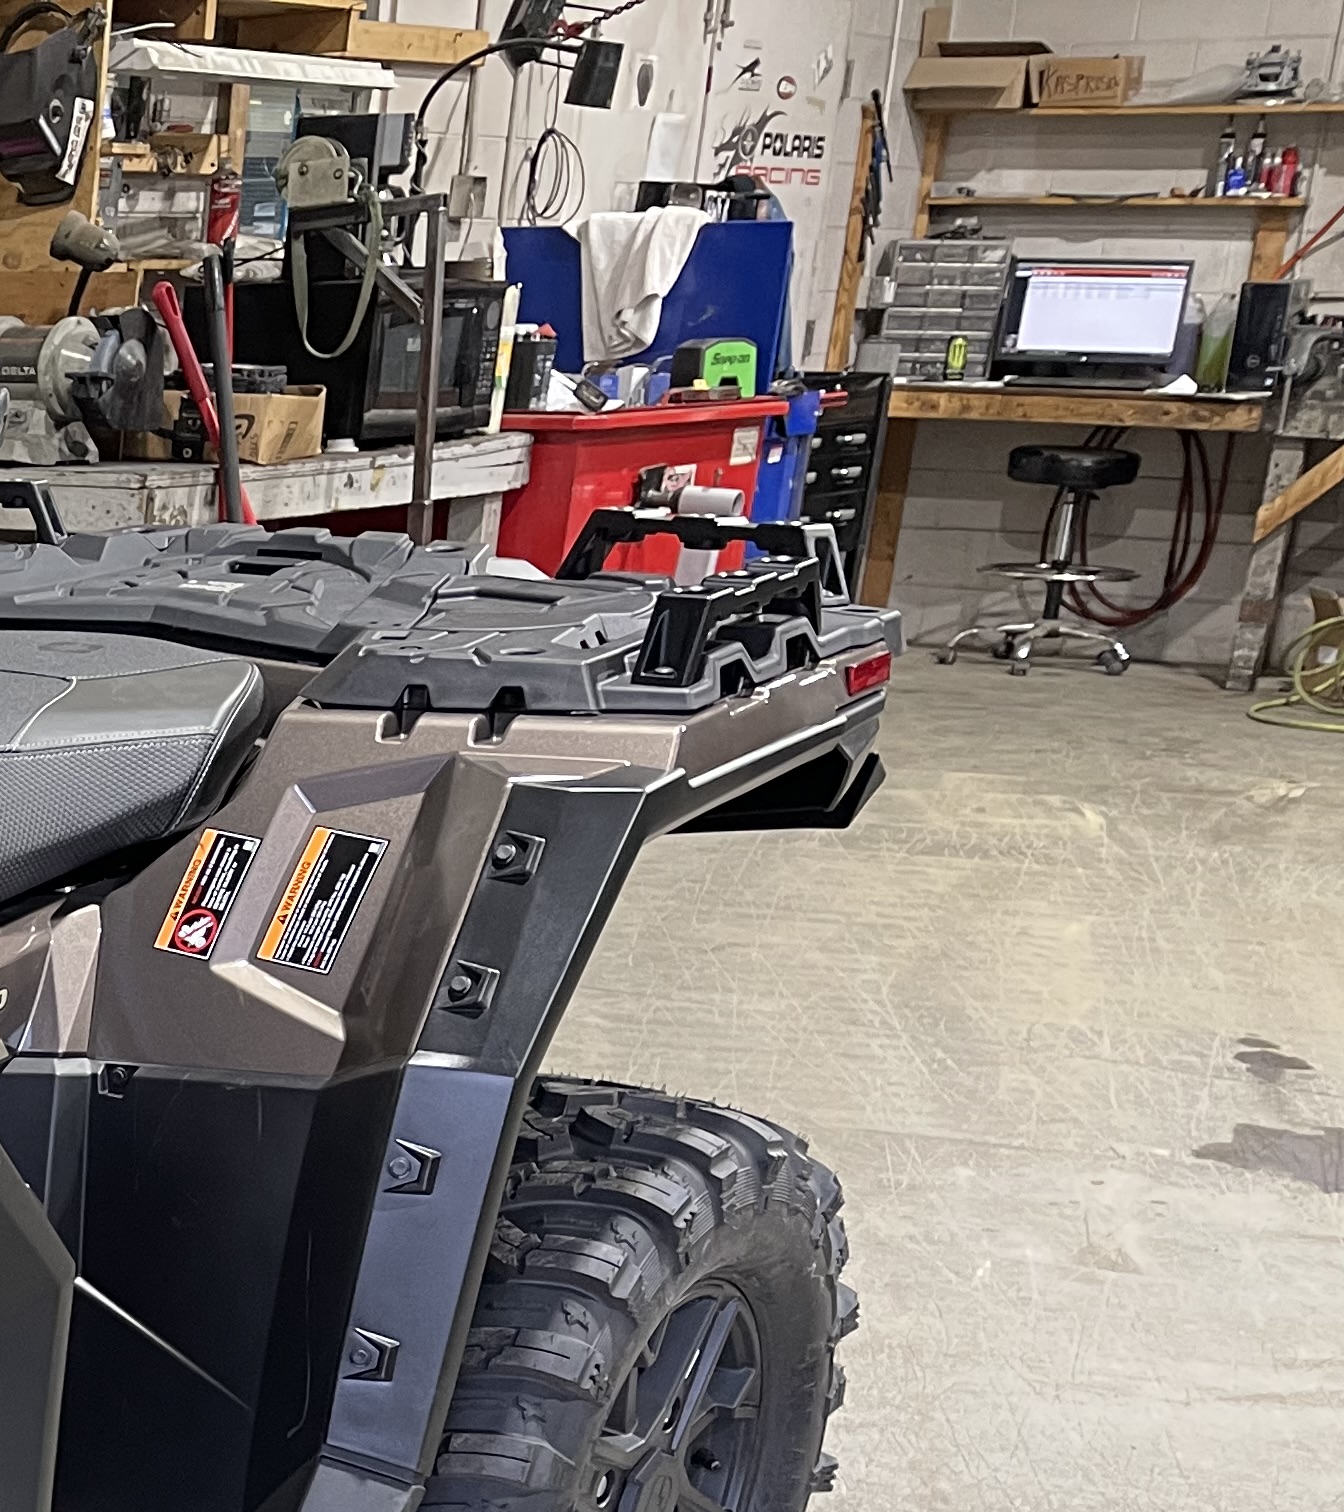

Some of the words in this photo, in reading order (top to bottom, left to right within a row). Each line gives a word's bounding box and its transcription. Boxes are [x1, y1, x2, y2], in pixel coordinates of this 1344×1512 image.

[762, 132, 825, 160] POLARIS
[736, 165, 821, 186] RACING
[0, 366, 37, 376] DELTA
[172, 857, 204, 911] WARNING
[282, 859, 313, 913] WARNING
